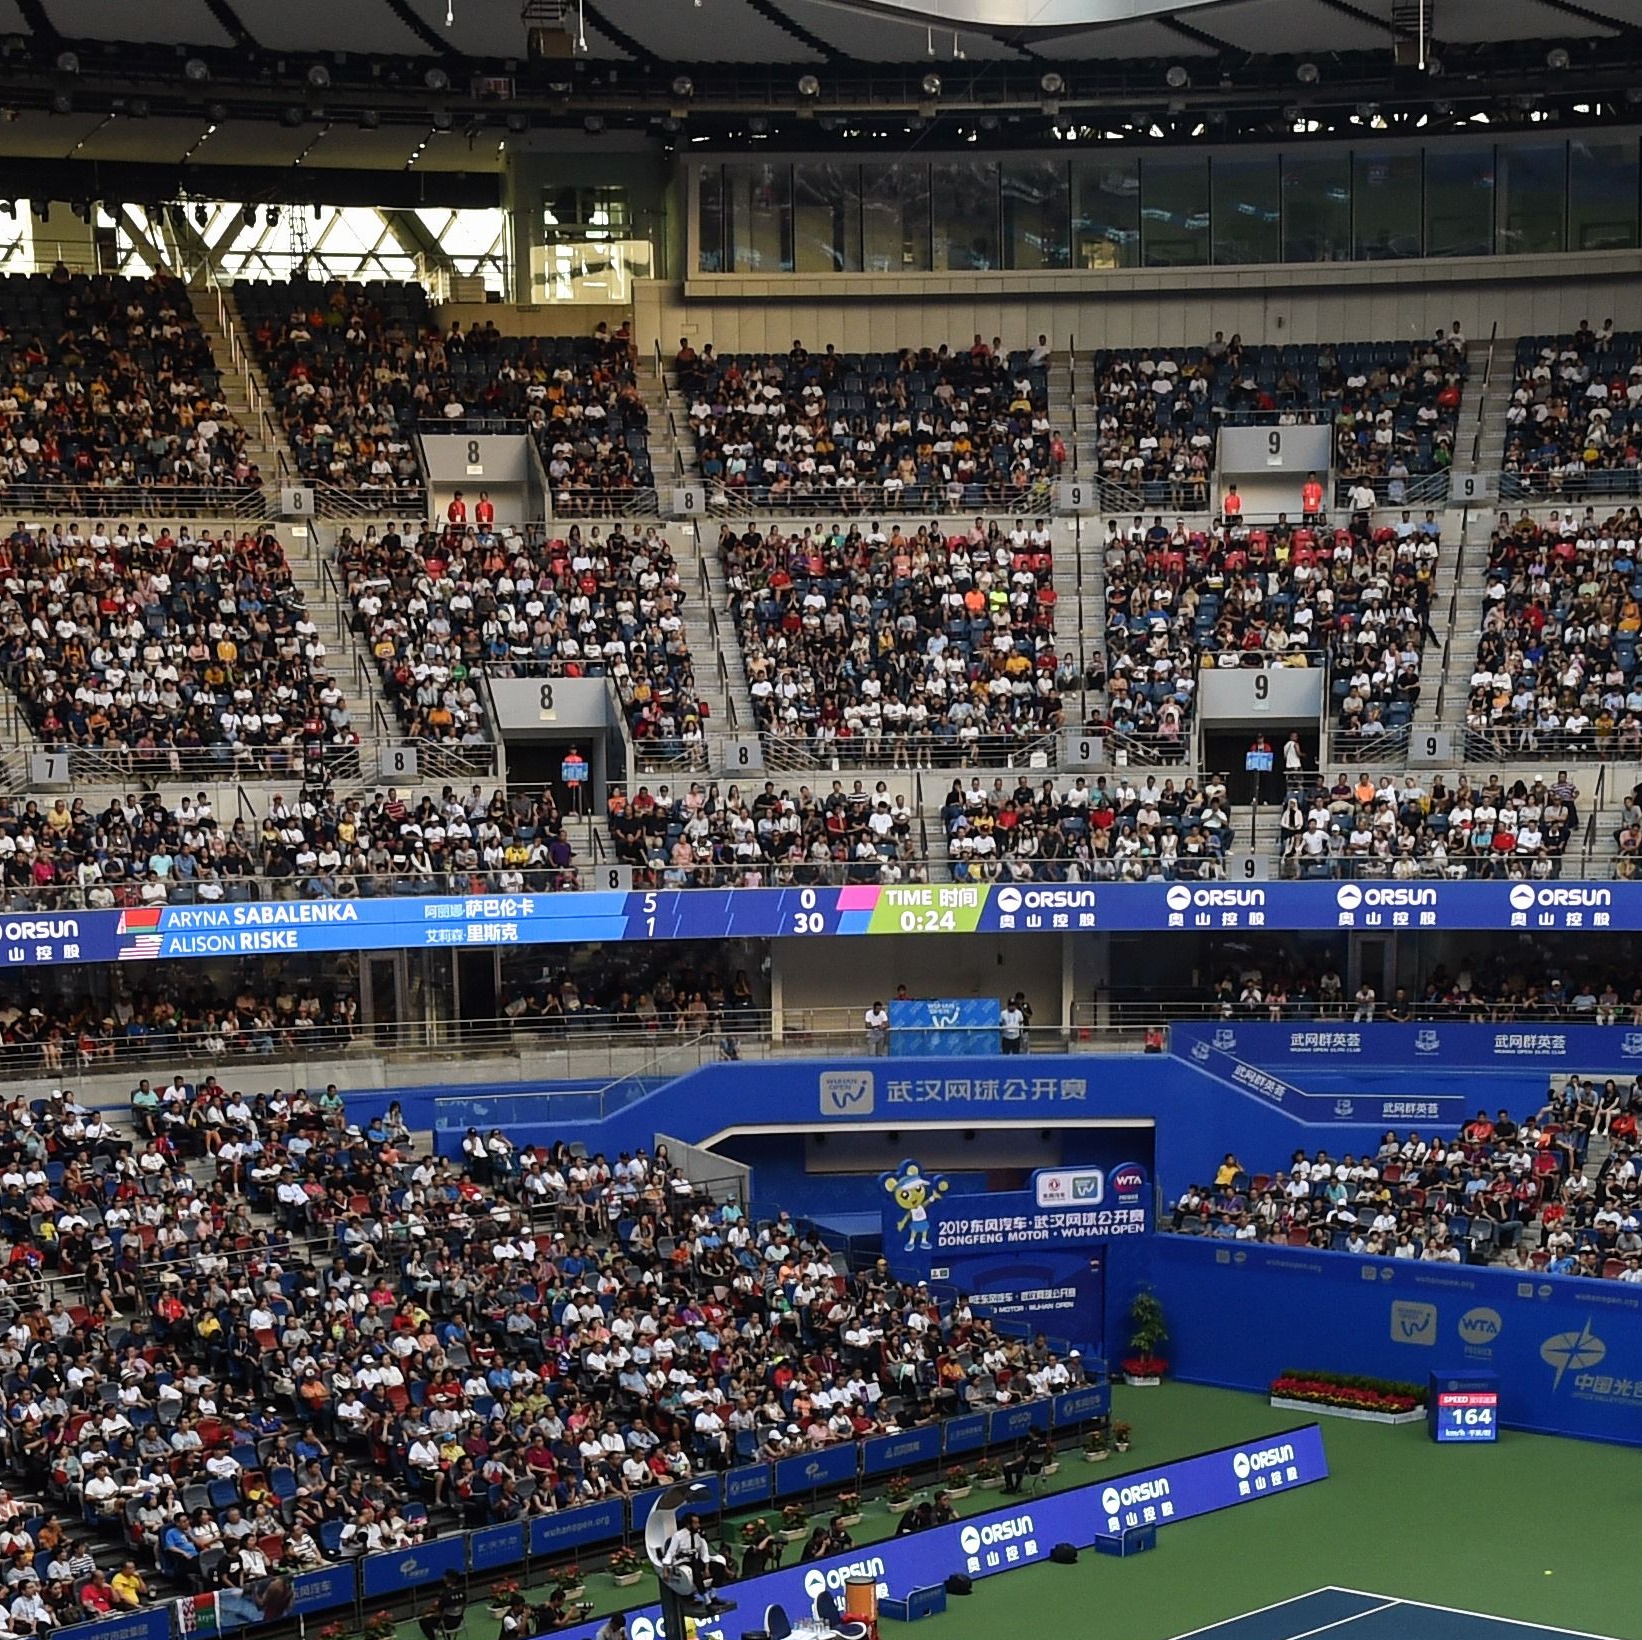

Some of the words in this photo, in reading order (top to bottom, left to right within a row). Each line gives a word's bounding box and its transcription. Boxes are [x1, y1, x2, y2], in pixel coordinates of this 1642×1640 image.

[1268, 431, 1281, 455] 9
[540, 684, 554, 710] 8
[1254, 674, 1269, 700] 9
[608, 869, 620, 889] 8
[1244, 858, 1255, 879] 9
[642, 892, 658, 913] 5
[800, 888, 816, 910] 0
[885, 888, 933, 907] TIME
[939, 887, 978, 908] 时间
[1024, 890, 1095, 909] ORSUN
[1364, 888, 1437, 906] ORSUN
[167, 910, 230, 928] ARYNA
[233, 901, 358, 925] SABALENKA
[793, 912, 824, 934] 30
[900, 911, 956, 932] 0:24
[999, 912, 1096, 929] 奥山控股
[1338, 911, 1436, 926] 奥山控股
[646, 916, 656, 937] 1
[169, 934, 236, 953] ALISON
[240, 930, 298, 950] RISKE
[1494, 1034, 1566, 1049] 武网群英荟
[887, 1079, 1087, 1103] 武汉网球公开赛
[1116, 1175, 1142, 1185] WTA
[938, 1233, 1004, 1247] DONGFENG
[1007, 1230, 1049, 1241] MOTOR
[1061, 1226, 1109, 1239] WUHAN
[1110, 1223, 1145, 1236] OPEN
[1462, 1317, 1498, 1334] WTA
[1443, 1394, 1469, 1404] SPEED
[1453, 1408, 1492, 1425] 164
[1250, 1444, 1293, 1470] ORSUN
[1239, 1466, 1297, 1495] 奥山控股
[543, 1513, 611, 1541] wuhanopen.org
[980, 1516, 1033, 1544] ORSUN
[967, 1540, 1038, 1573] 奥山控股
